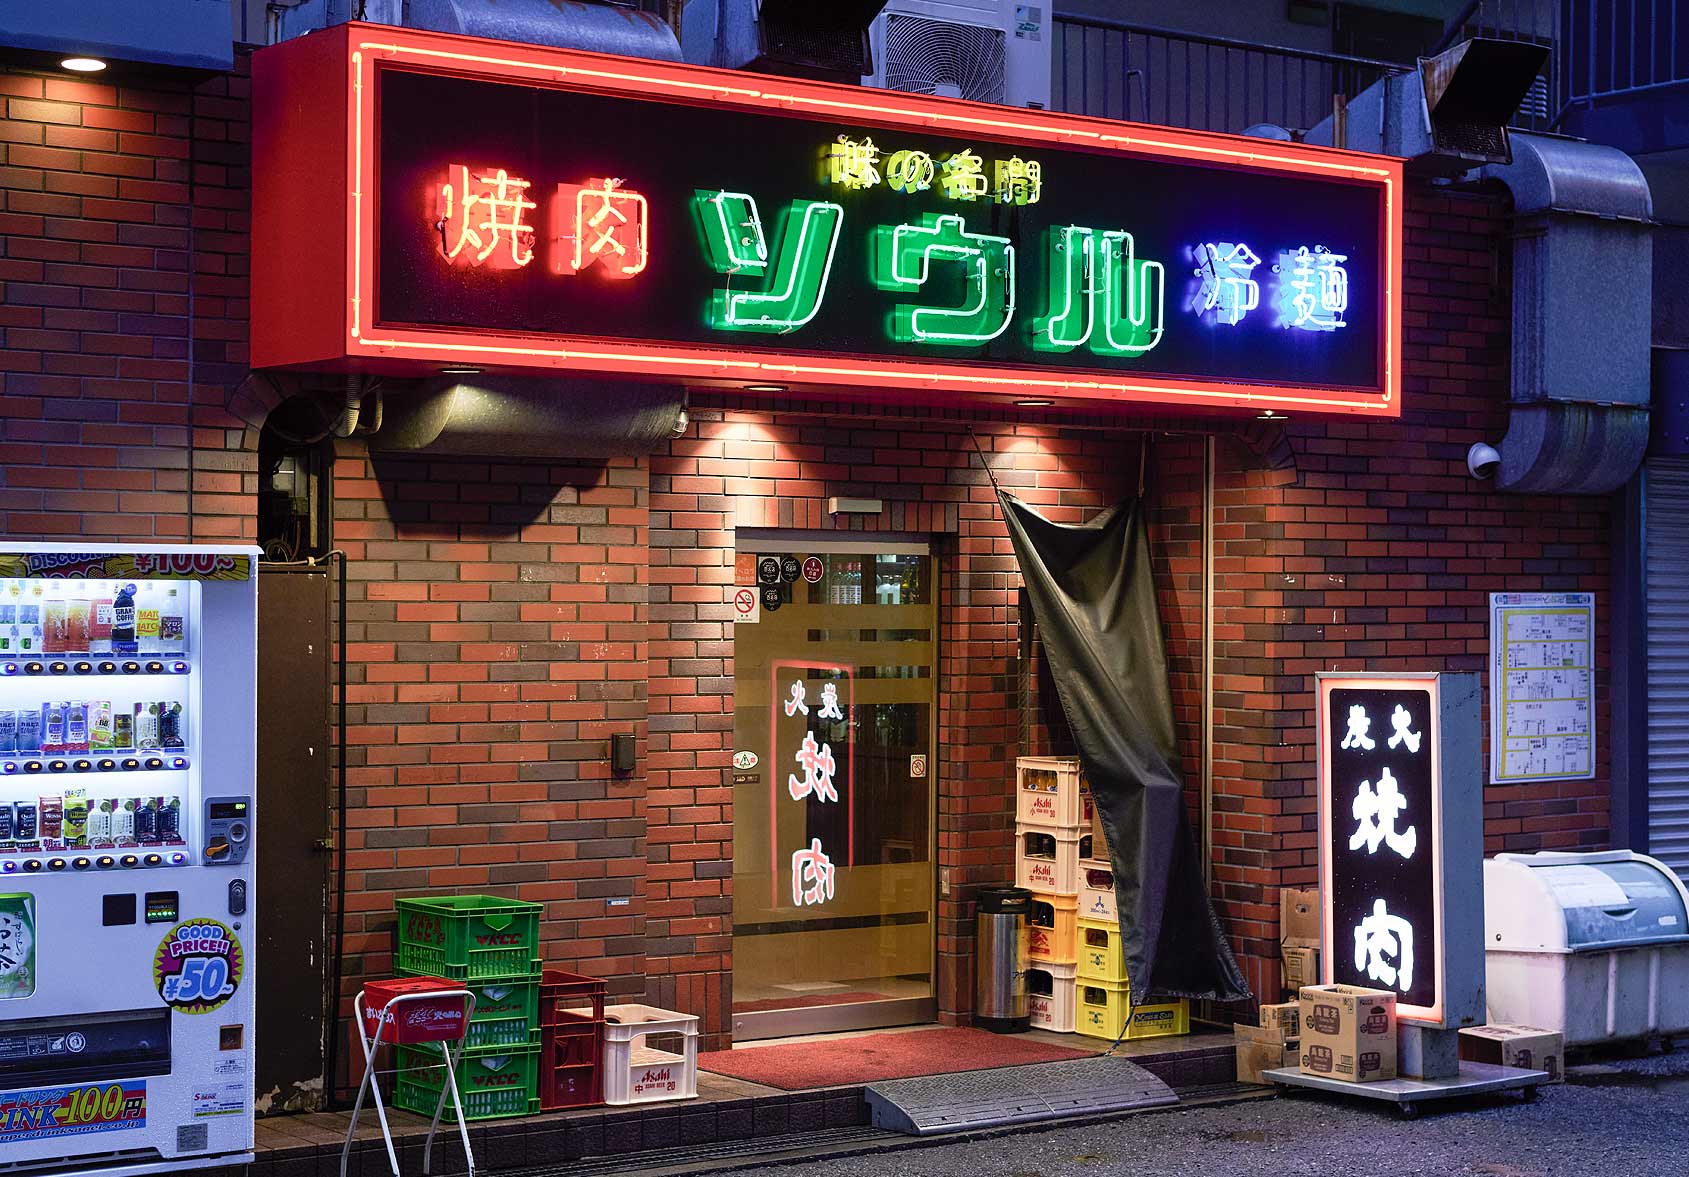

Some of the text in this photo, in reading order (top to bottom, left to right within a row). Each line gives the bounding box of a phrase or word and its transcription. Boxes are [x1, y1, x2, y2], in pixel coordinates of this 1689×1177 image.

[438, 164, 1348, 358] 焼肉 ソウル 冷麺
[1341, 703, 1422, 753] 炭火
[1033, 797, 1052, 809] Asahi
[1032, 864, 1051, 876] Asahi
[1349, 766, 1417, 993] 焼肉
[178, 926, 223, 940] GOOD
[171, 939, 229, 956] PRICE!!
[641, 1068, 671, 1083] Asahi
[634, 1084, 644, 1094] 中
[666, 1081, 676, 1092] 20
